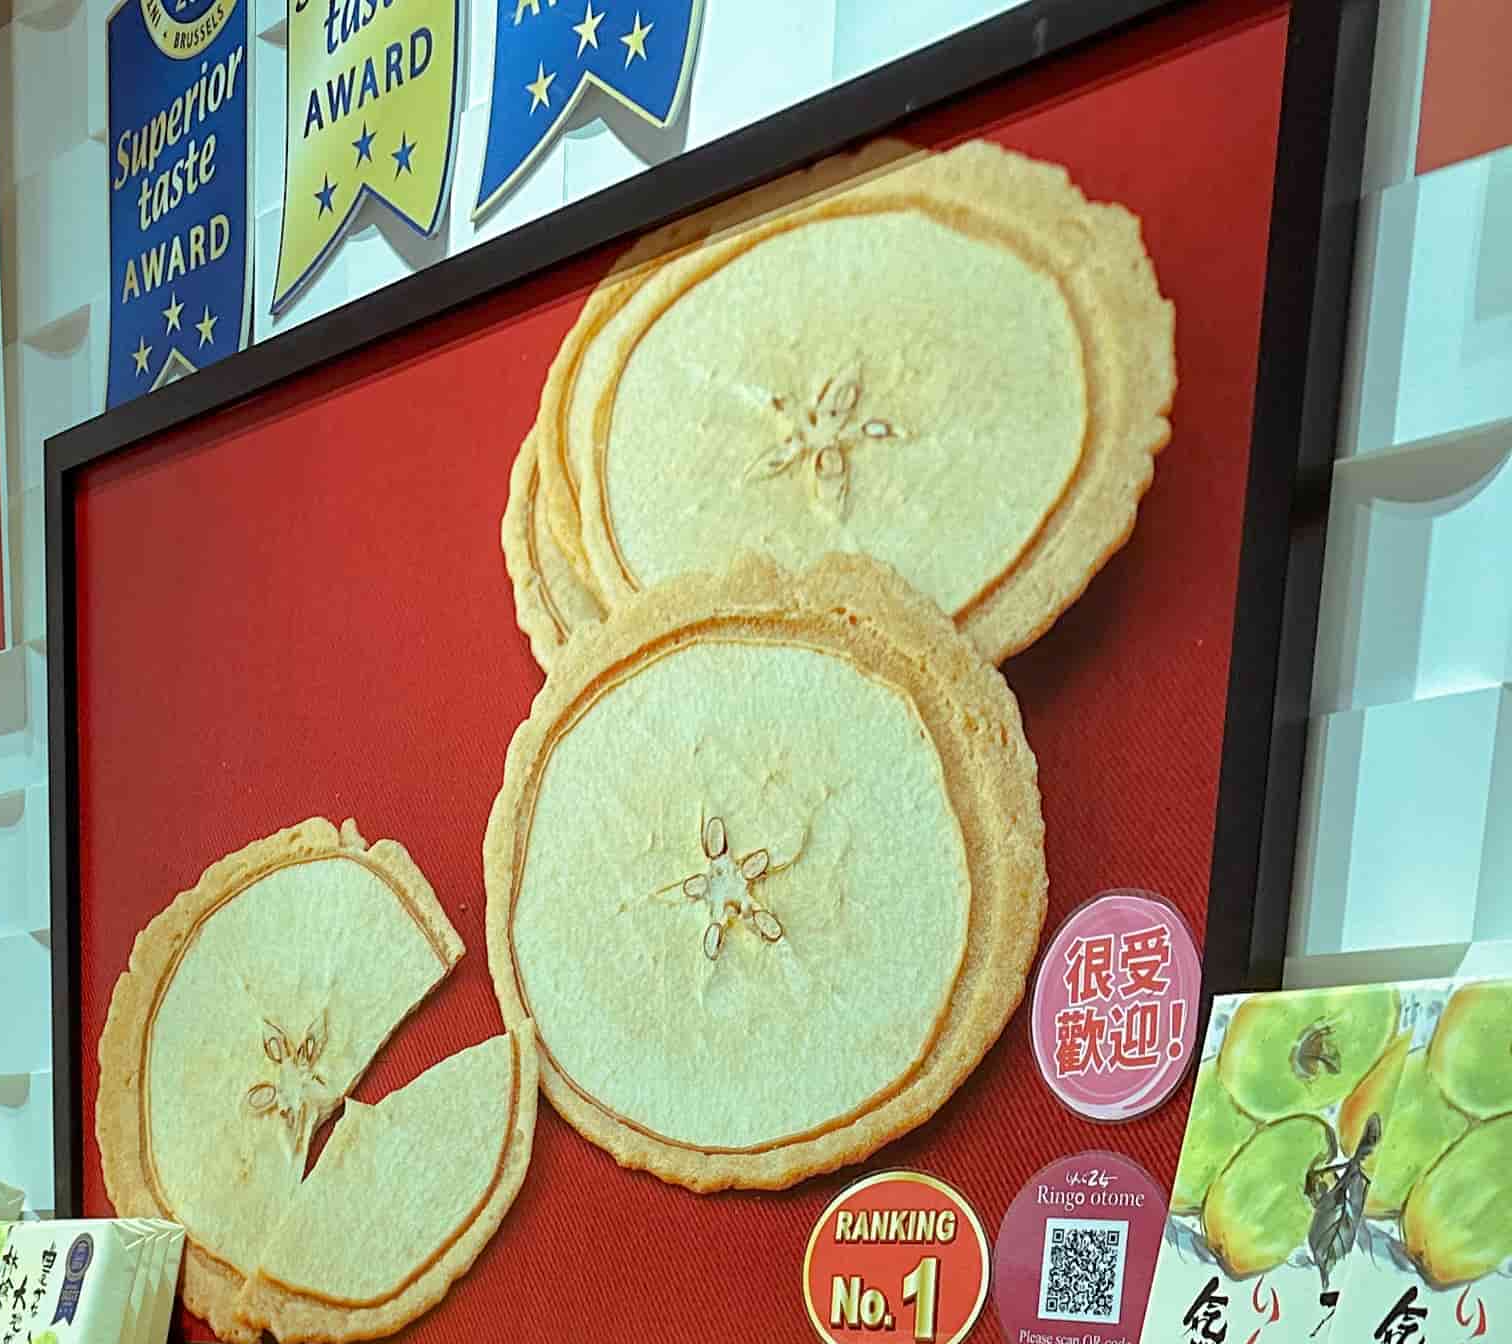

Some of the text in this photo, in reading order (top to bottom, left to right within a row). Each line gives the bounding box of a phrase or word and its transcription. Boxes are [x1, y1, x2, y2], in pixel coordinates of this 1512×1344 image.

[174, 6, 226, 49] BRUSSELS
[113, 46, 244, 191] Superior
[303, 26, 434, 138] AWARD
[137, 132, 217, 232] taste
[122, 214, 231, 303] AWARD
[1063, 924, 1171, 1006] 很受
[834, 1209, 956, 1244] RANKING
[1037, 1184, 1145, 1211] Ringo otome
